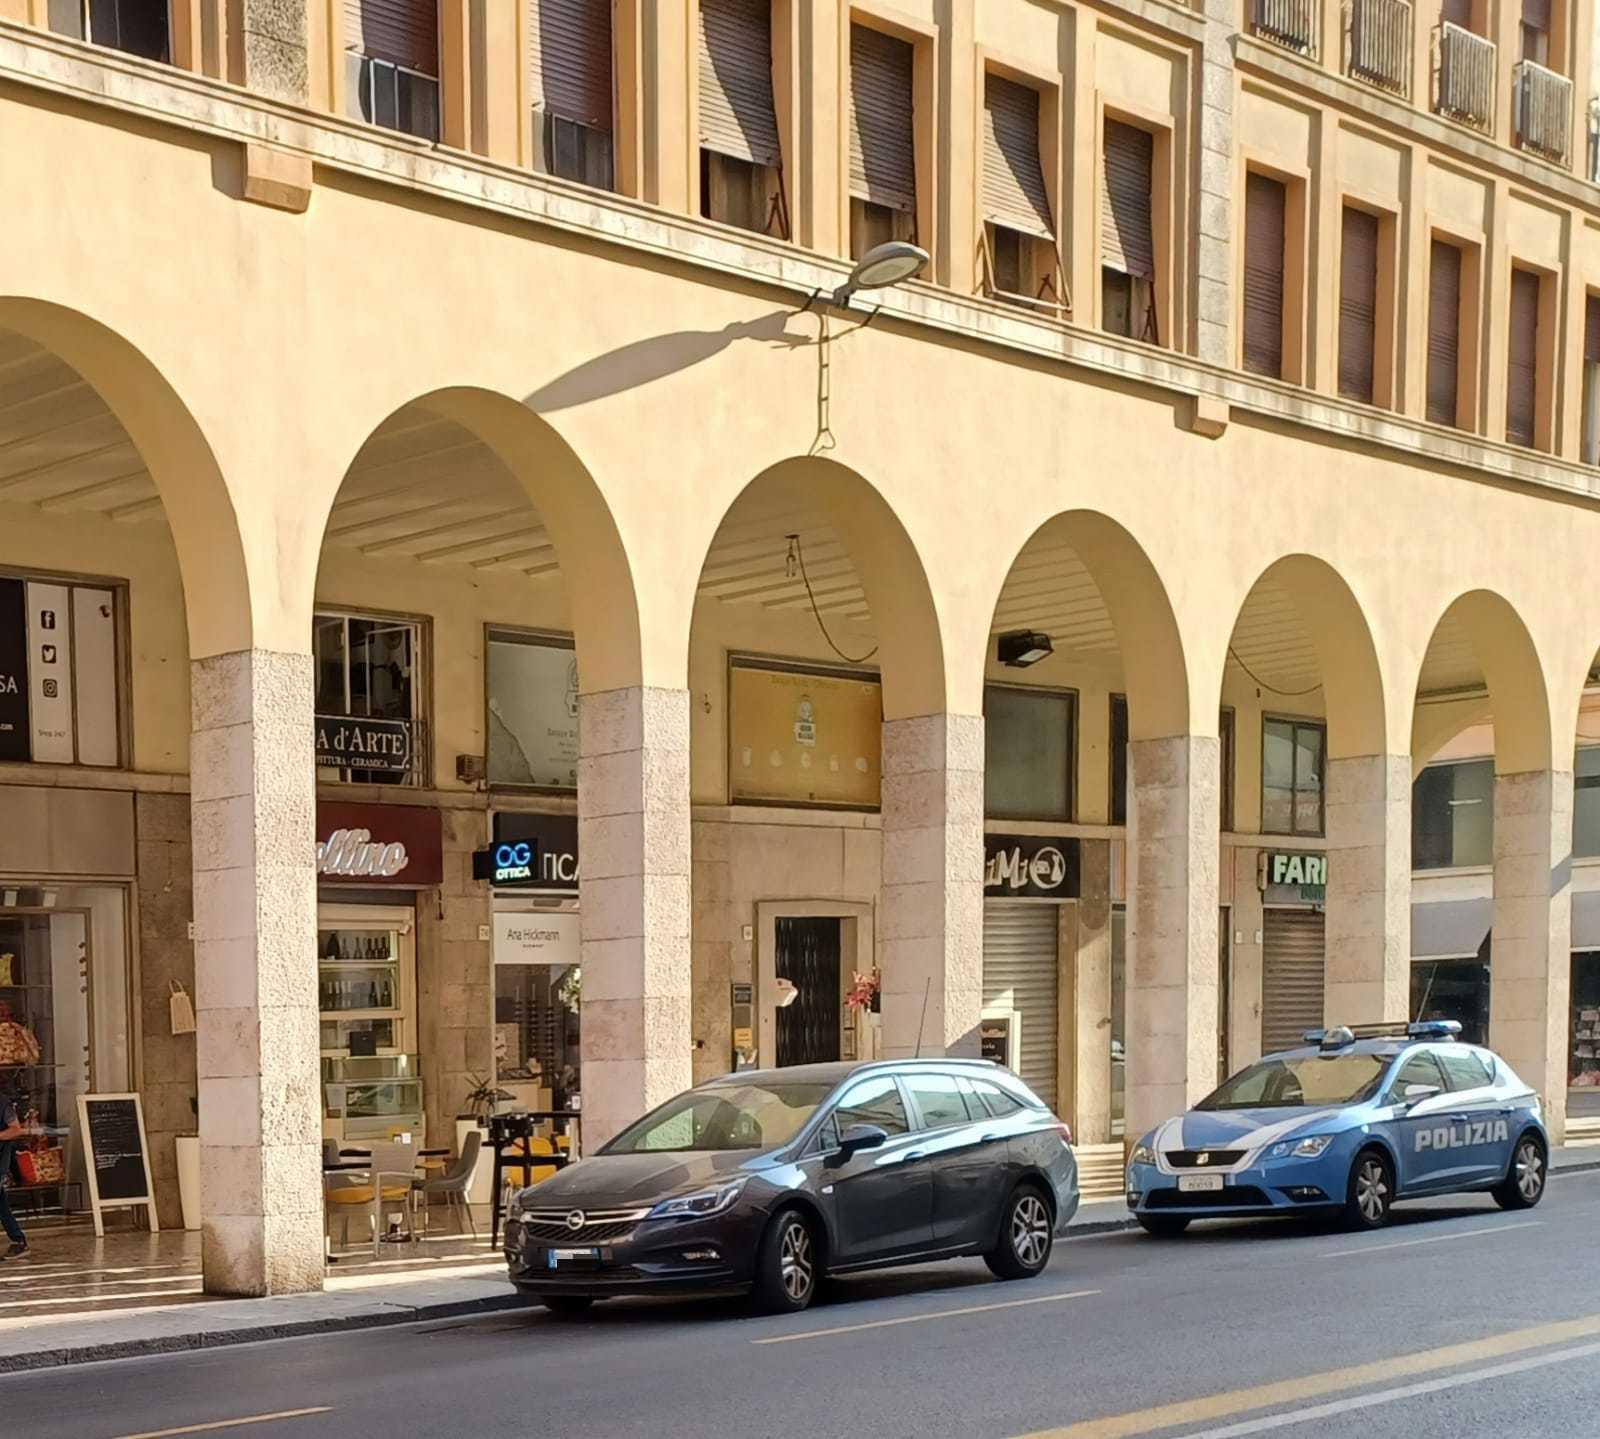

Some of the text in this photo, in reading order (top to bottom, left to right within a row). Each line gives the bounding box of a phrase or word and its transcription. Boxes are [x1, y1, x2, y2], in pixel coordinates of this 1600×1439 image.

[496, 866, 531, 880] OTTICA
[506, 928, 523, 941] Ana
[1414, 1119, 1508, 1153] POLIZIA
